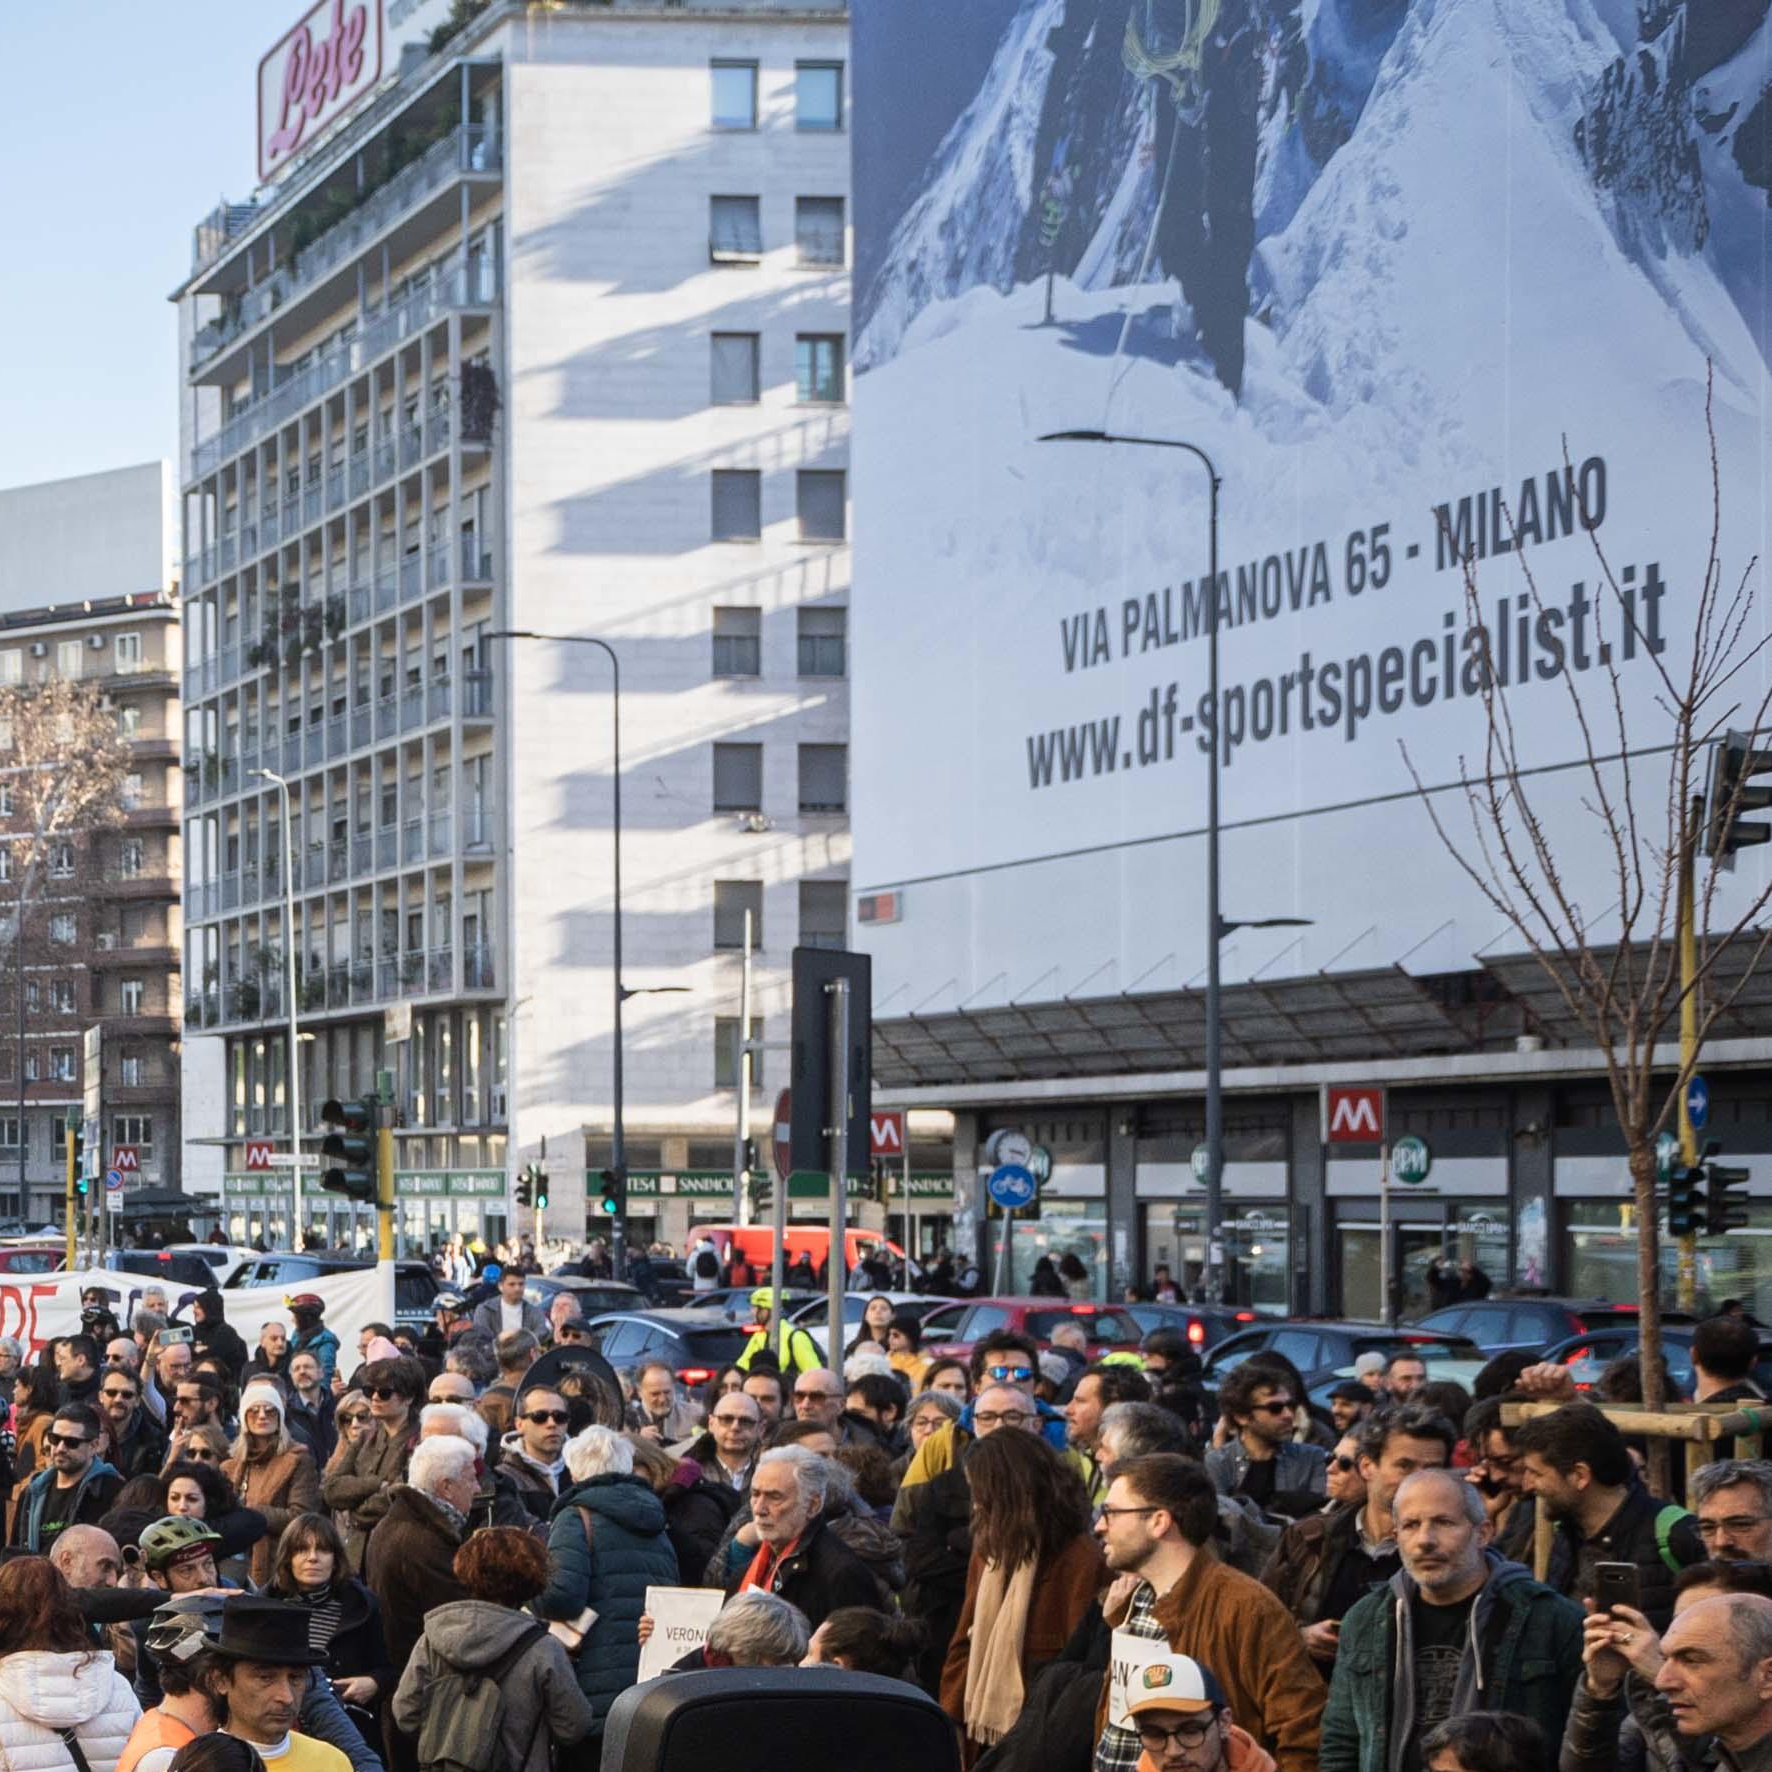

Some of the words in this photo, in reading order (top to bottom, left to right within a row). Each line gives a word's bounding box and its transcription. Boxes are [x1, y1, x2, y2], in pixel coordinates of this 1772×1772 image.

[1061, 616, 1110, 673] VIA
[1121, 540, 1332, 658] PALMANOVA
[1345, 521, 1391, 597] 65
[1434, 456, 1608, 571] MILANO
[1026, 562, 1666, 789] www.df-sportspecialist.it
[1330, 1097, 1379, 1131] M
[116, 1150, 137, 1167] M
[1391, 1146, 1427, 1173] BPM
[626, 1176, 656, 1192] TESA
